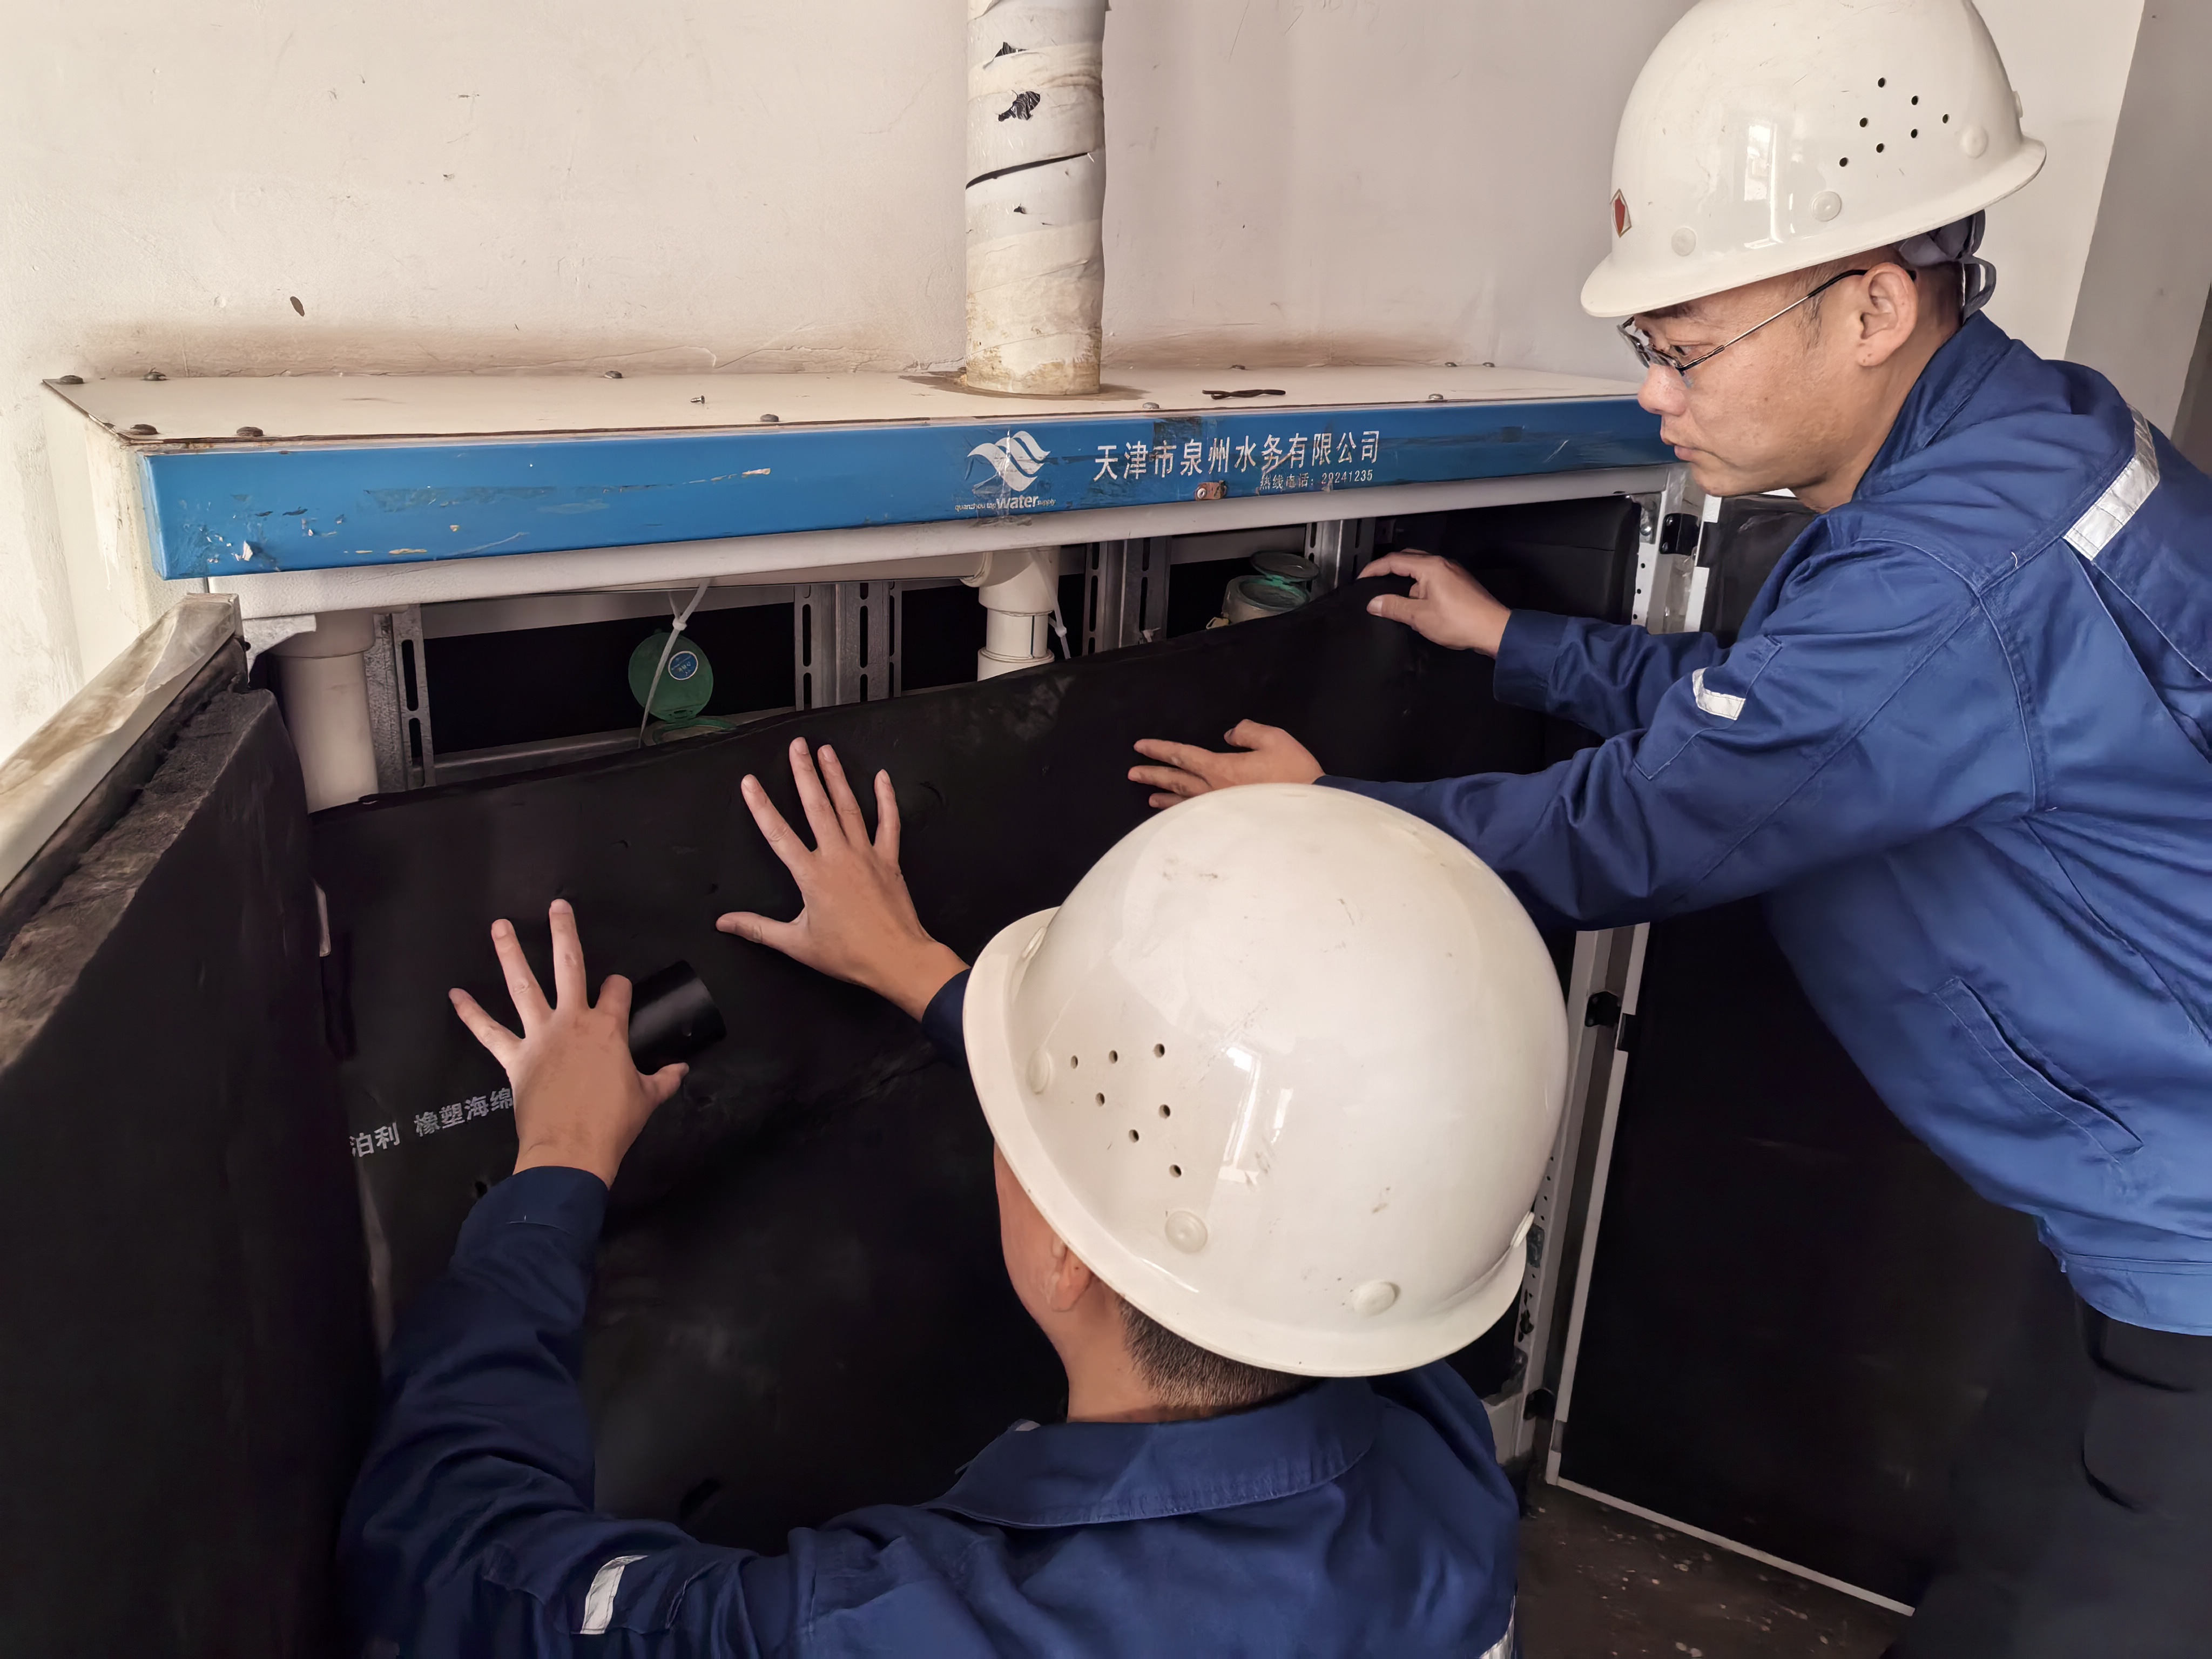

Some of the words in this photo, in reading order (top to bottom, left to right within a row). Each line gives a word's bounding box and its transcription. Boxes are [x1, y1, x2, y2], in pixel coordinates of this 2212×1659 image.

[1092, 430, 1379, 482] 天津市泉州水务有限公司
[414, 1087, 513, 1137] 橡塑海绵
